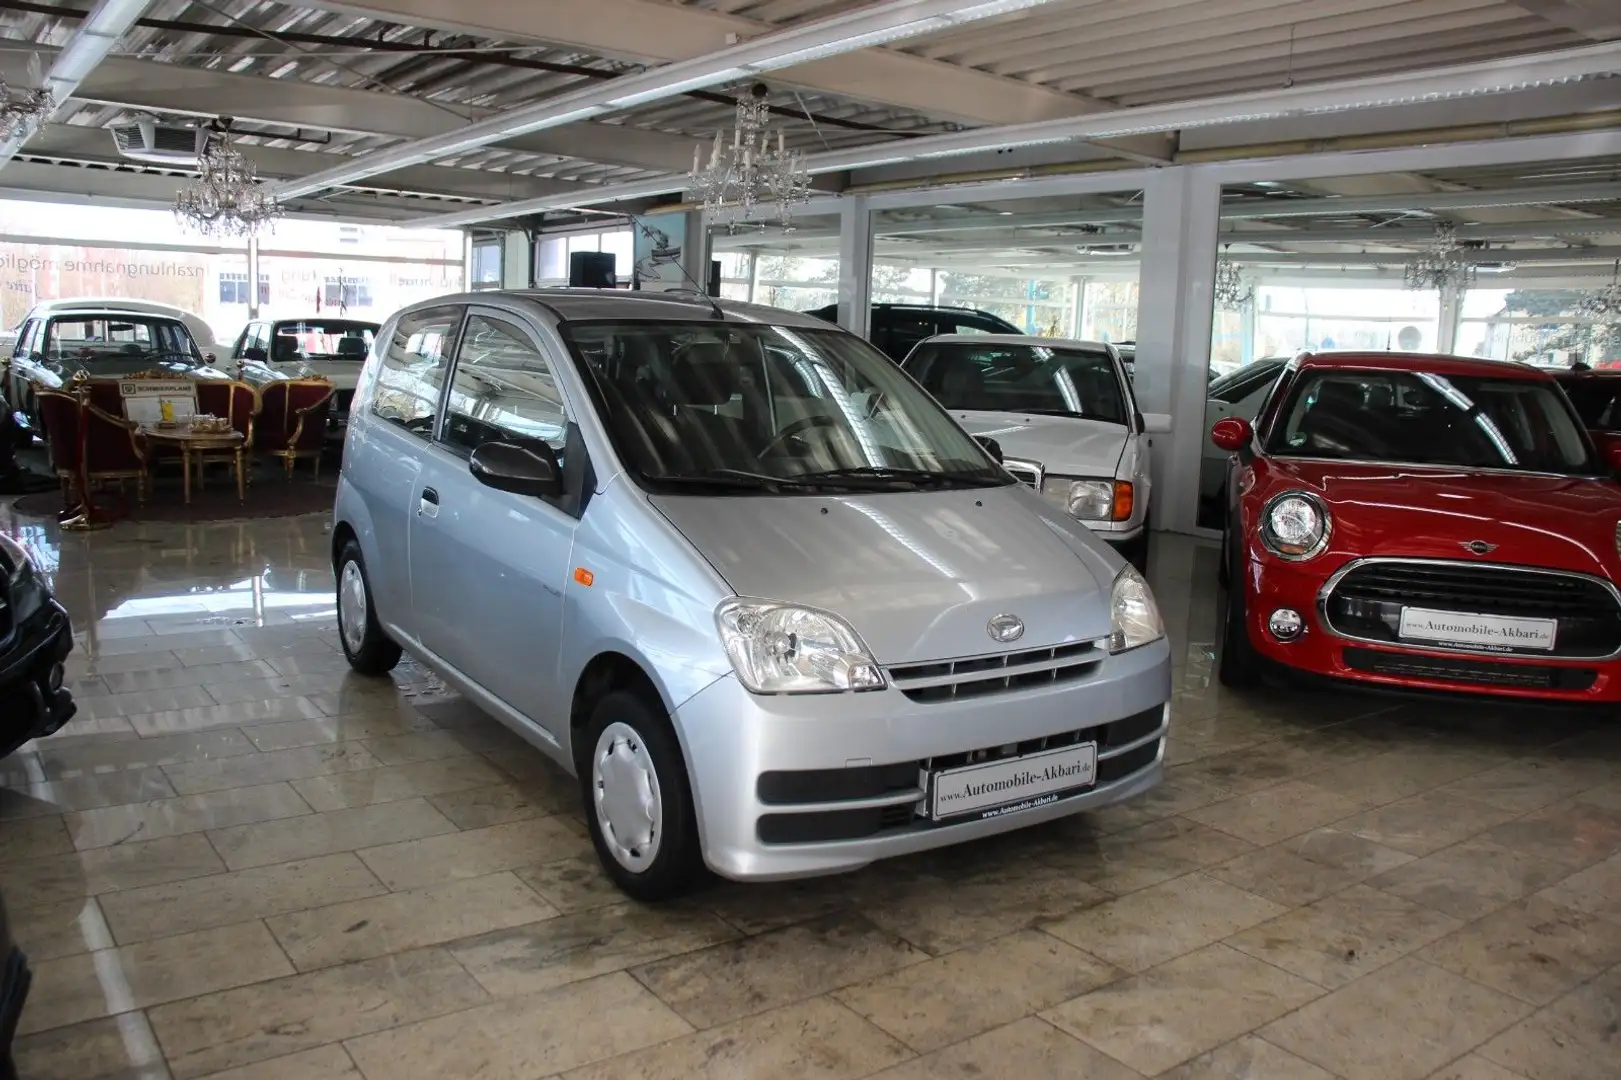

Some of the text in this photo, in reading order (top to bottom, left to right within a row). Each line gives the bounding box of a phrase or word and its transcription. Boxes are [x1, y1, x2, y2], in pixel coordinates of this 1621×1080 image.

[1405, 619, 1550, 640] www.Automobile-Akbari.de
[940, 760, 1091, 802] www.Automobile-Akbari.de
[981, 794, 1059, 819] www.Automobile-Akbari.de
